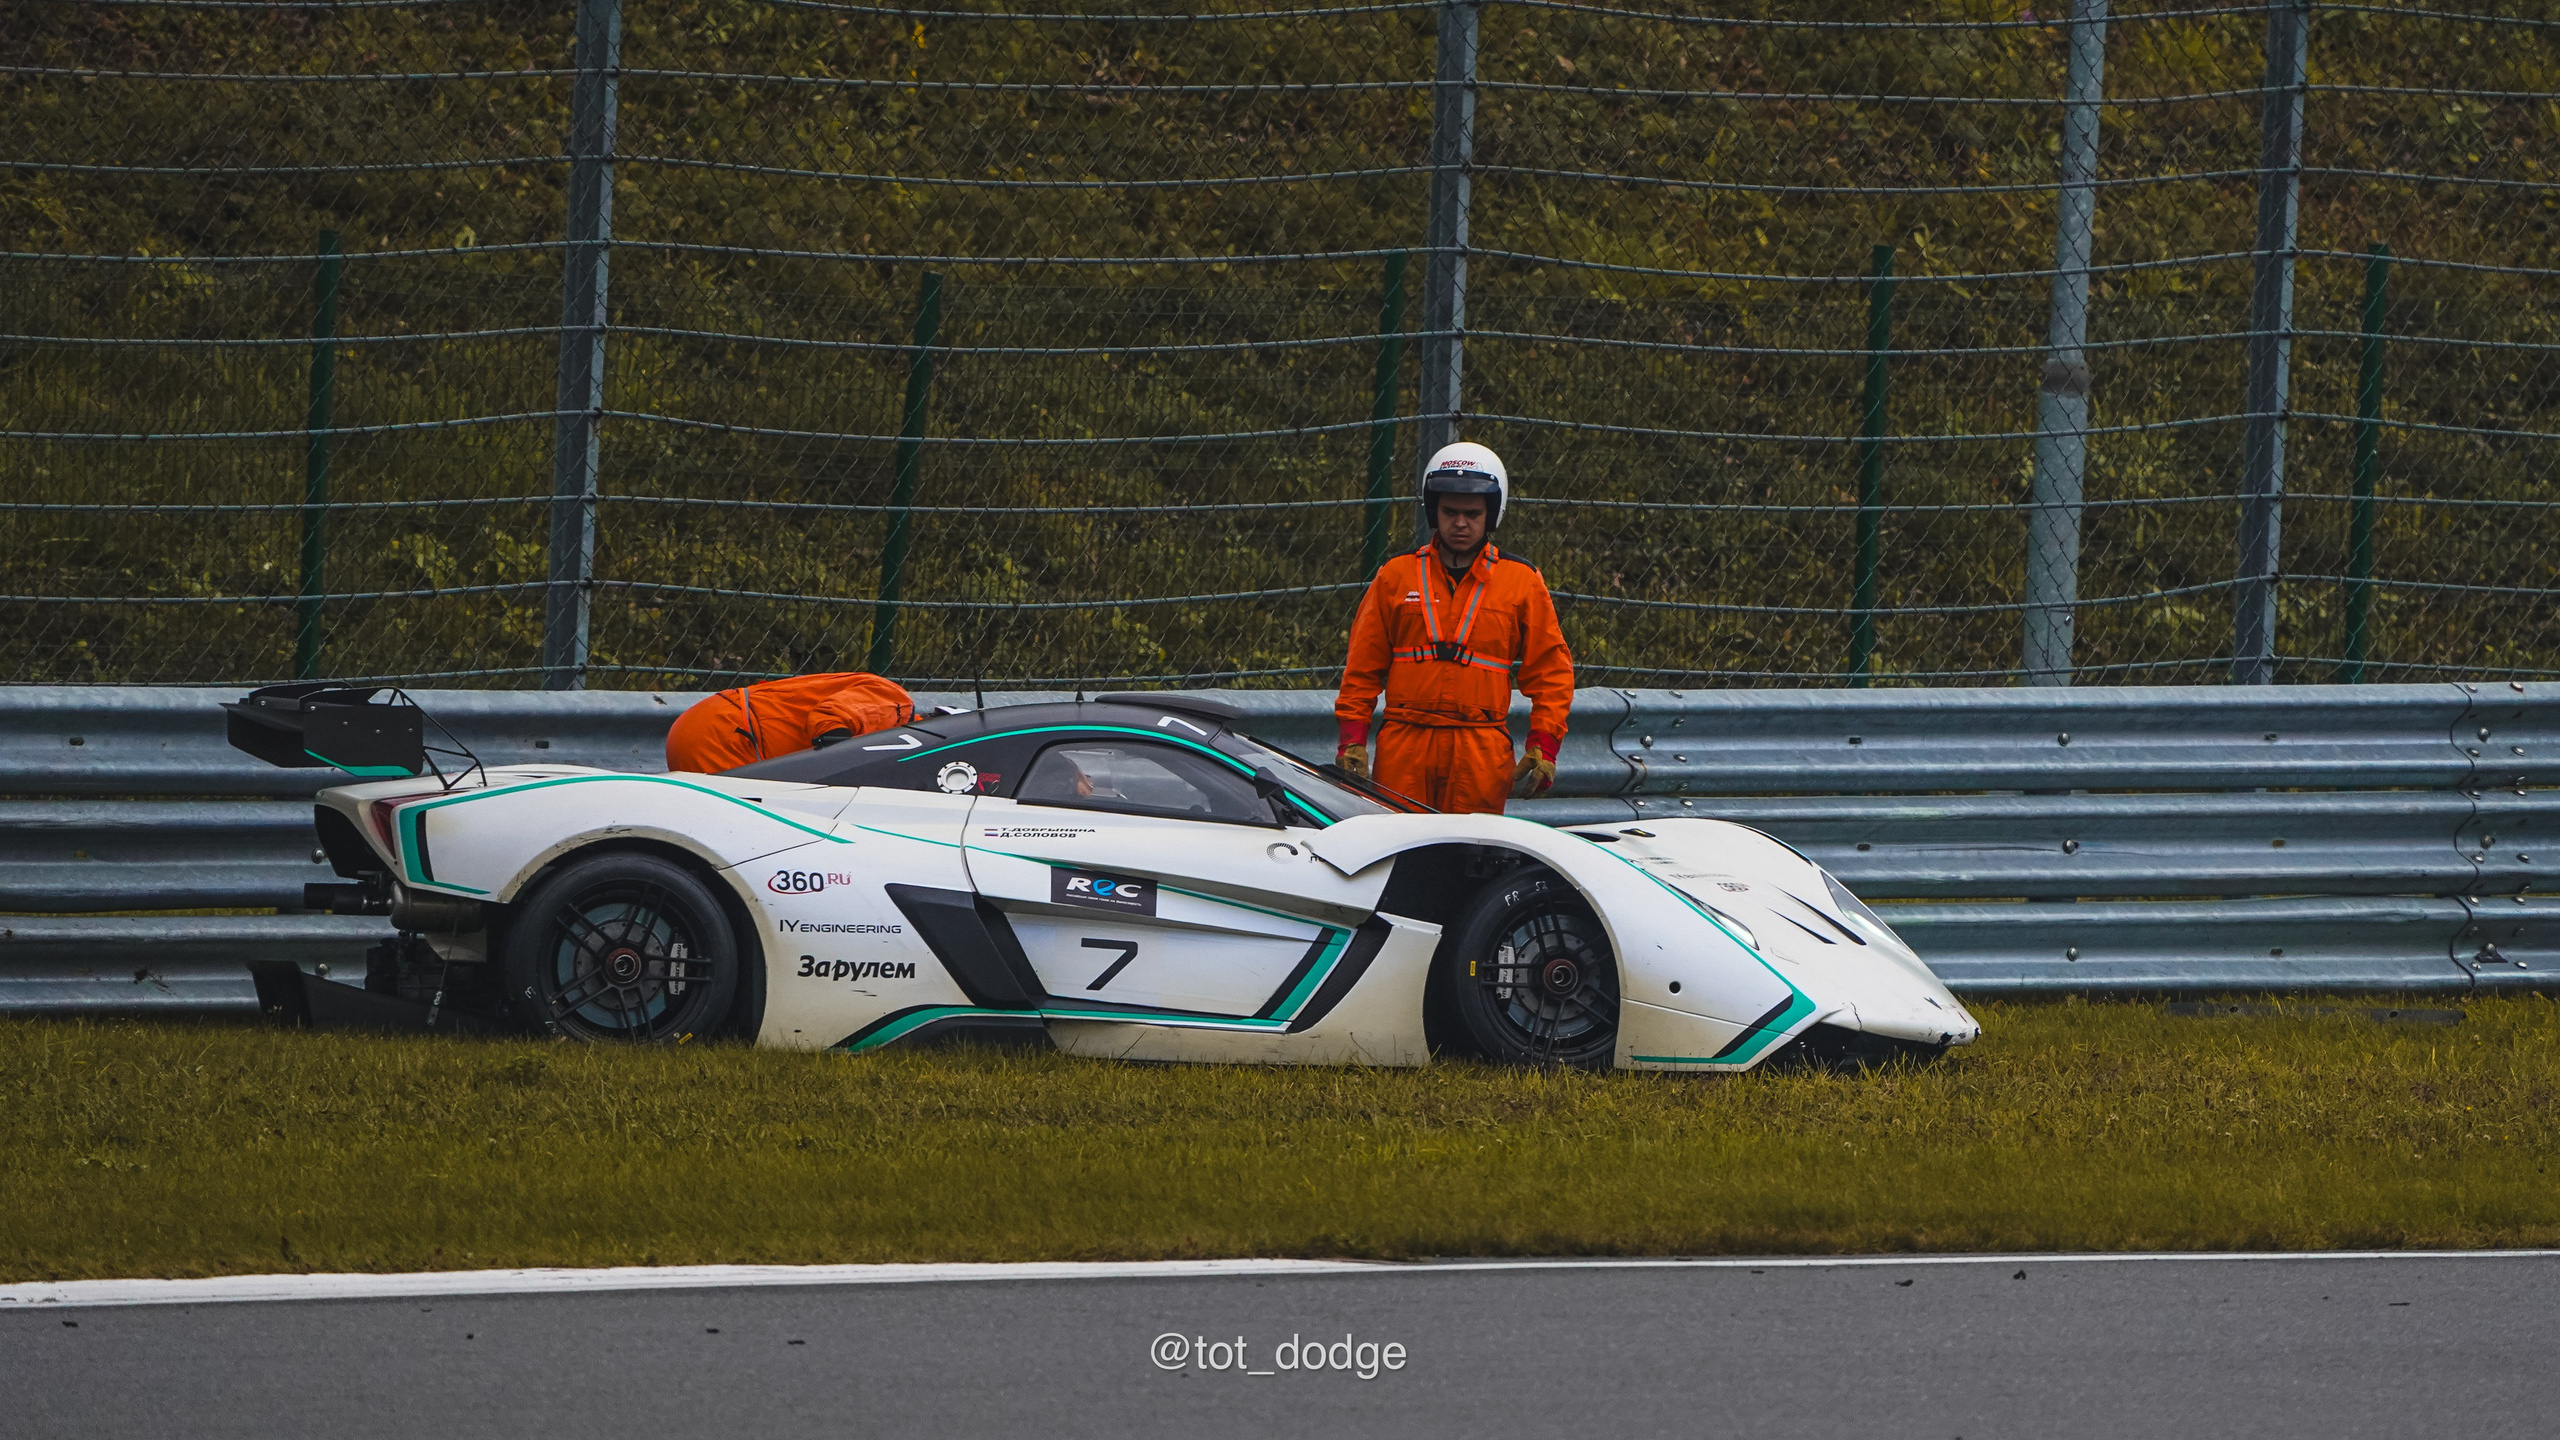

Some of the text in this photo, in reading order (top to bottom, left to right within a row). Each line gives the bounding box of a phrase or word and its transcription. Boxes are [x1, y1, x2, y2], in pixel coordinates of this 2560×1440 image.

[1441, 459, 1476, 467] MOSCOW
[1157, 715, 1208, 736] 7
[862, 733, 923, 751] 7
[1081, 937, 1138, 991] 7
